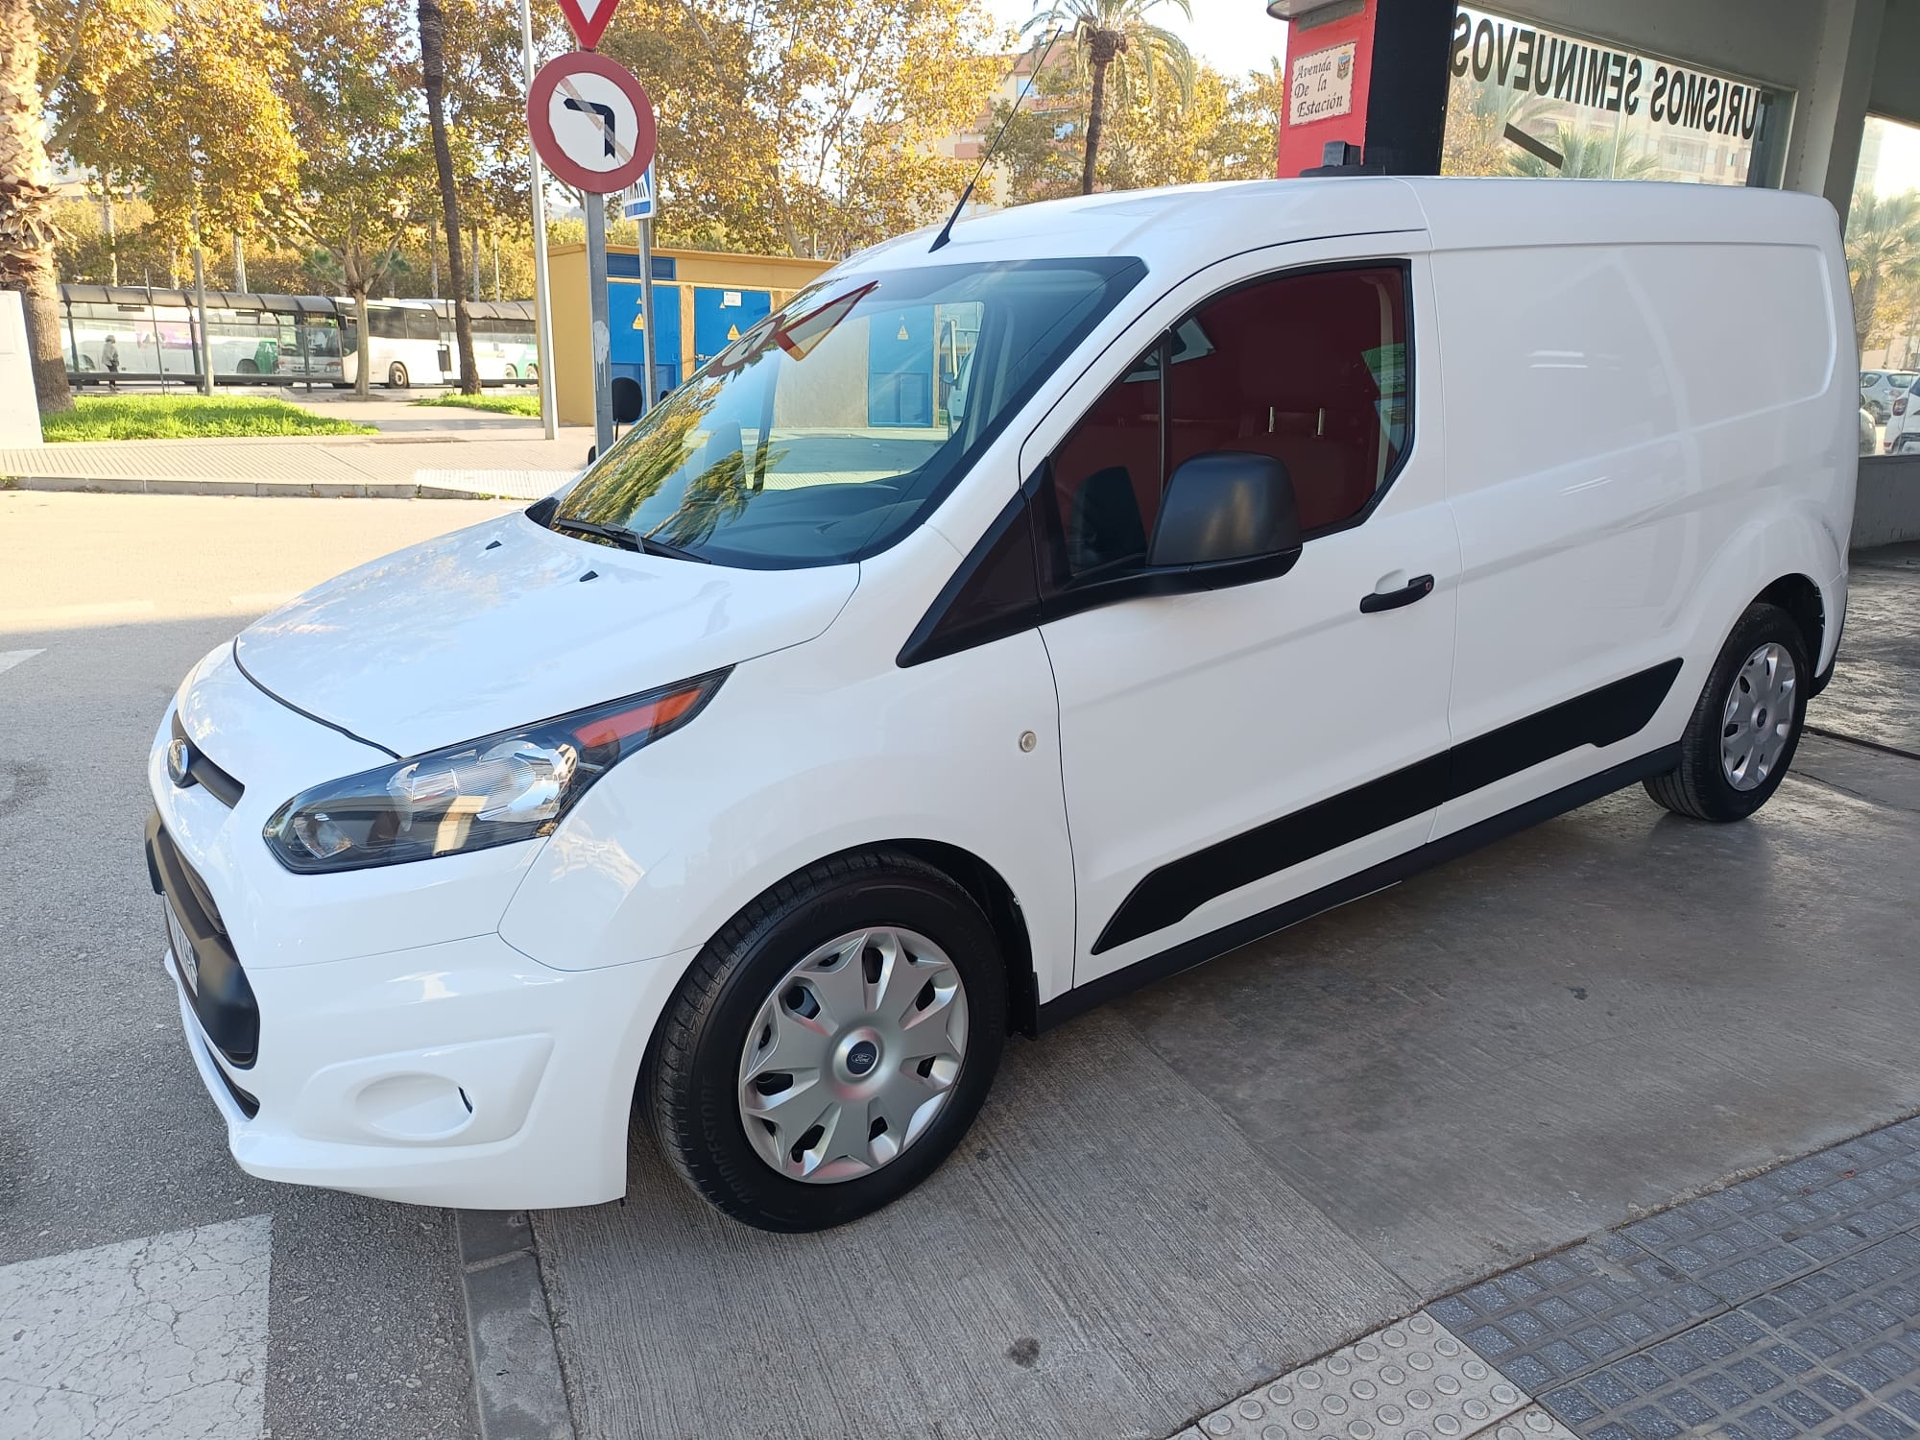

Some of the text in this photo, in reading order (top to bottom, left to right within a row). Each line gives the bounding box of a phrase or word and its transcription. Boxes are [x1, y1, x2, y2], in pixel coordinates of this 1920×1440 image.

[1295, 55, 1331, 82] Avenida
[1294, 73, 1327, 99] De la
[1297, 92, 1343, 117] Estación
